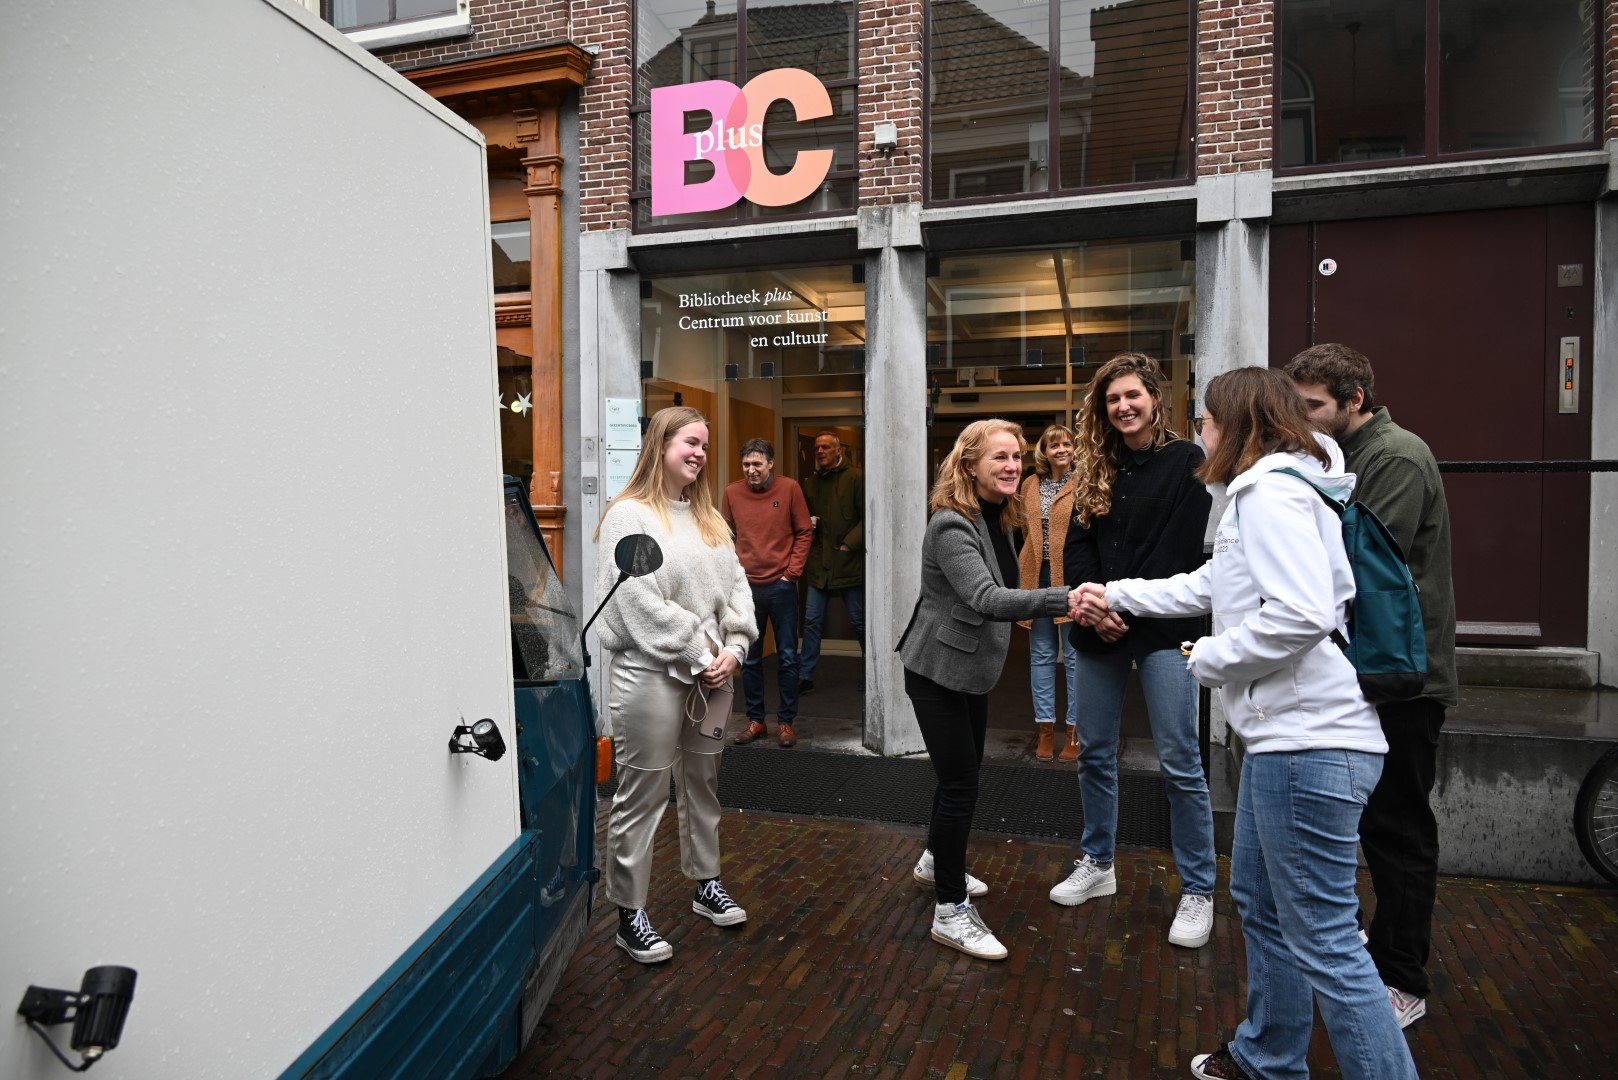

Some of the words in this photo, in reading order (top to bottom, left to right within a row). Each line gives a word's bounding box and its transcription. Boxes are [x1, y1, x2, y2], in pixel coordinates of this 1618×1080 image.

[693, 119, 763, 160] plus
[678, 289, 761, 308] Bibliotheek
[763, 287, 793, 306] plus
[678, 314, 744, 330] Centrum
[748, 312, 782, 326] voor
[786, 308, 828, 324] kunst
[750, 336, 768, 348] en
[773, 330, 828, 347] cultuur
